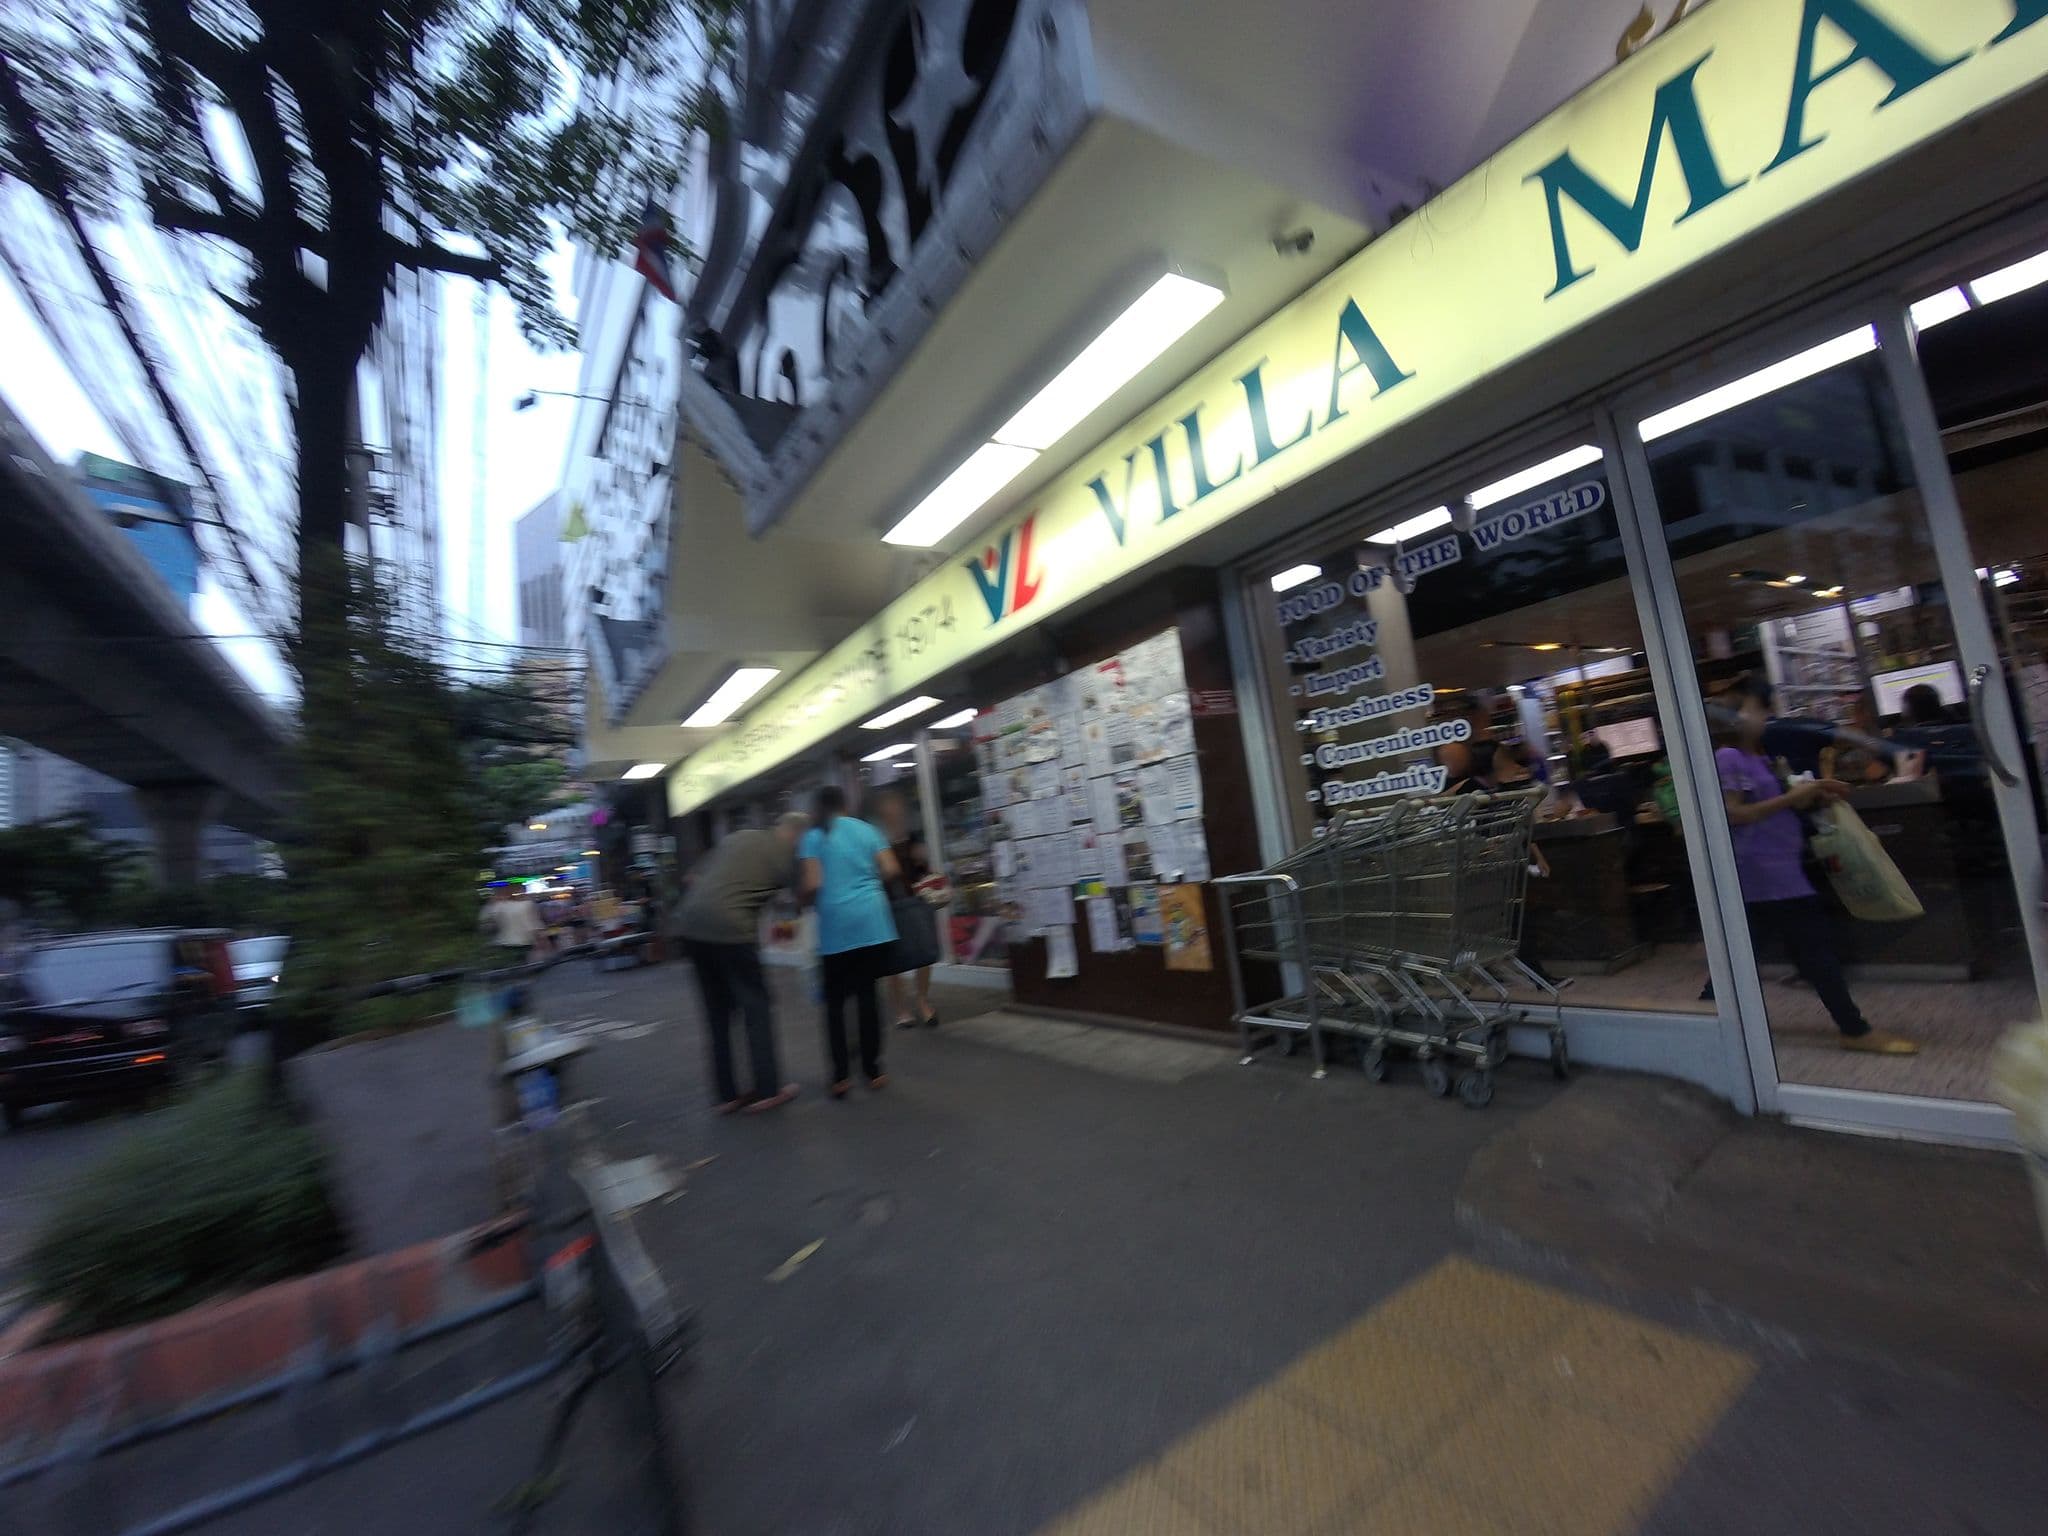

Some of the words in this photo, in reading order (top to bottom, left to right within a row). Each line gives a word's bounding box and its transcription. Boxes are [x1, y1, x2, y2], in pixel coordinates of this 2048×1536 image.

[1084, 294, 1418, 548] VILLA
[1521, 0, 2048, 301] MA
[1277, 584, 1344, 626] FOOD
[1350, 565, 1387, 596] OF
[1397, 536, 1459, 579] THE
[1472, 484, 1603, 549] WORLD
[1296, 620, 1379, 661] Variety
[1305, 656, 1383, 696] Import
[1310, 684, 1433, 732] Freshness
[1317, 720, 1470, 767] Convenience
[1323, 766, 1447, 805] Proximity
